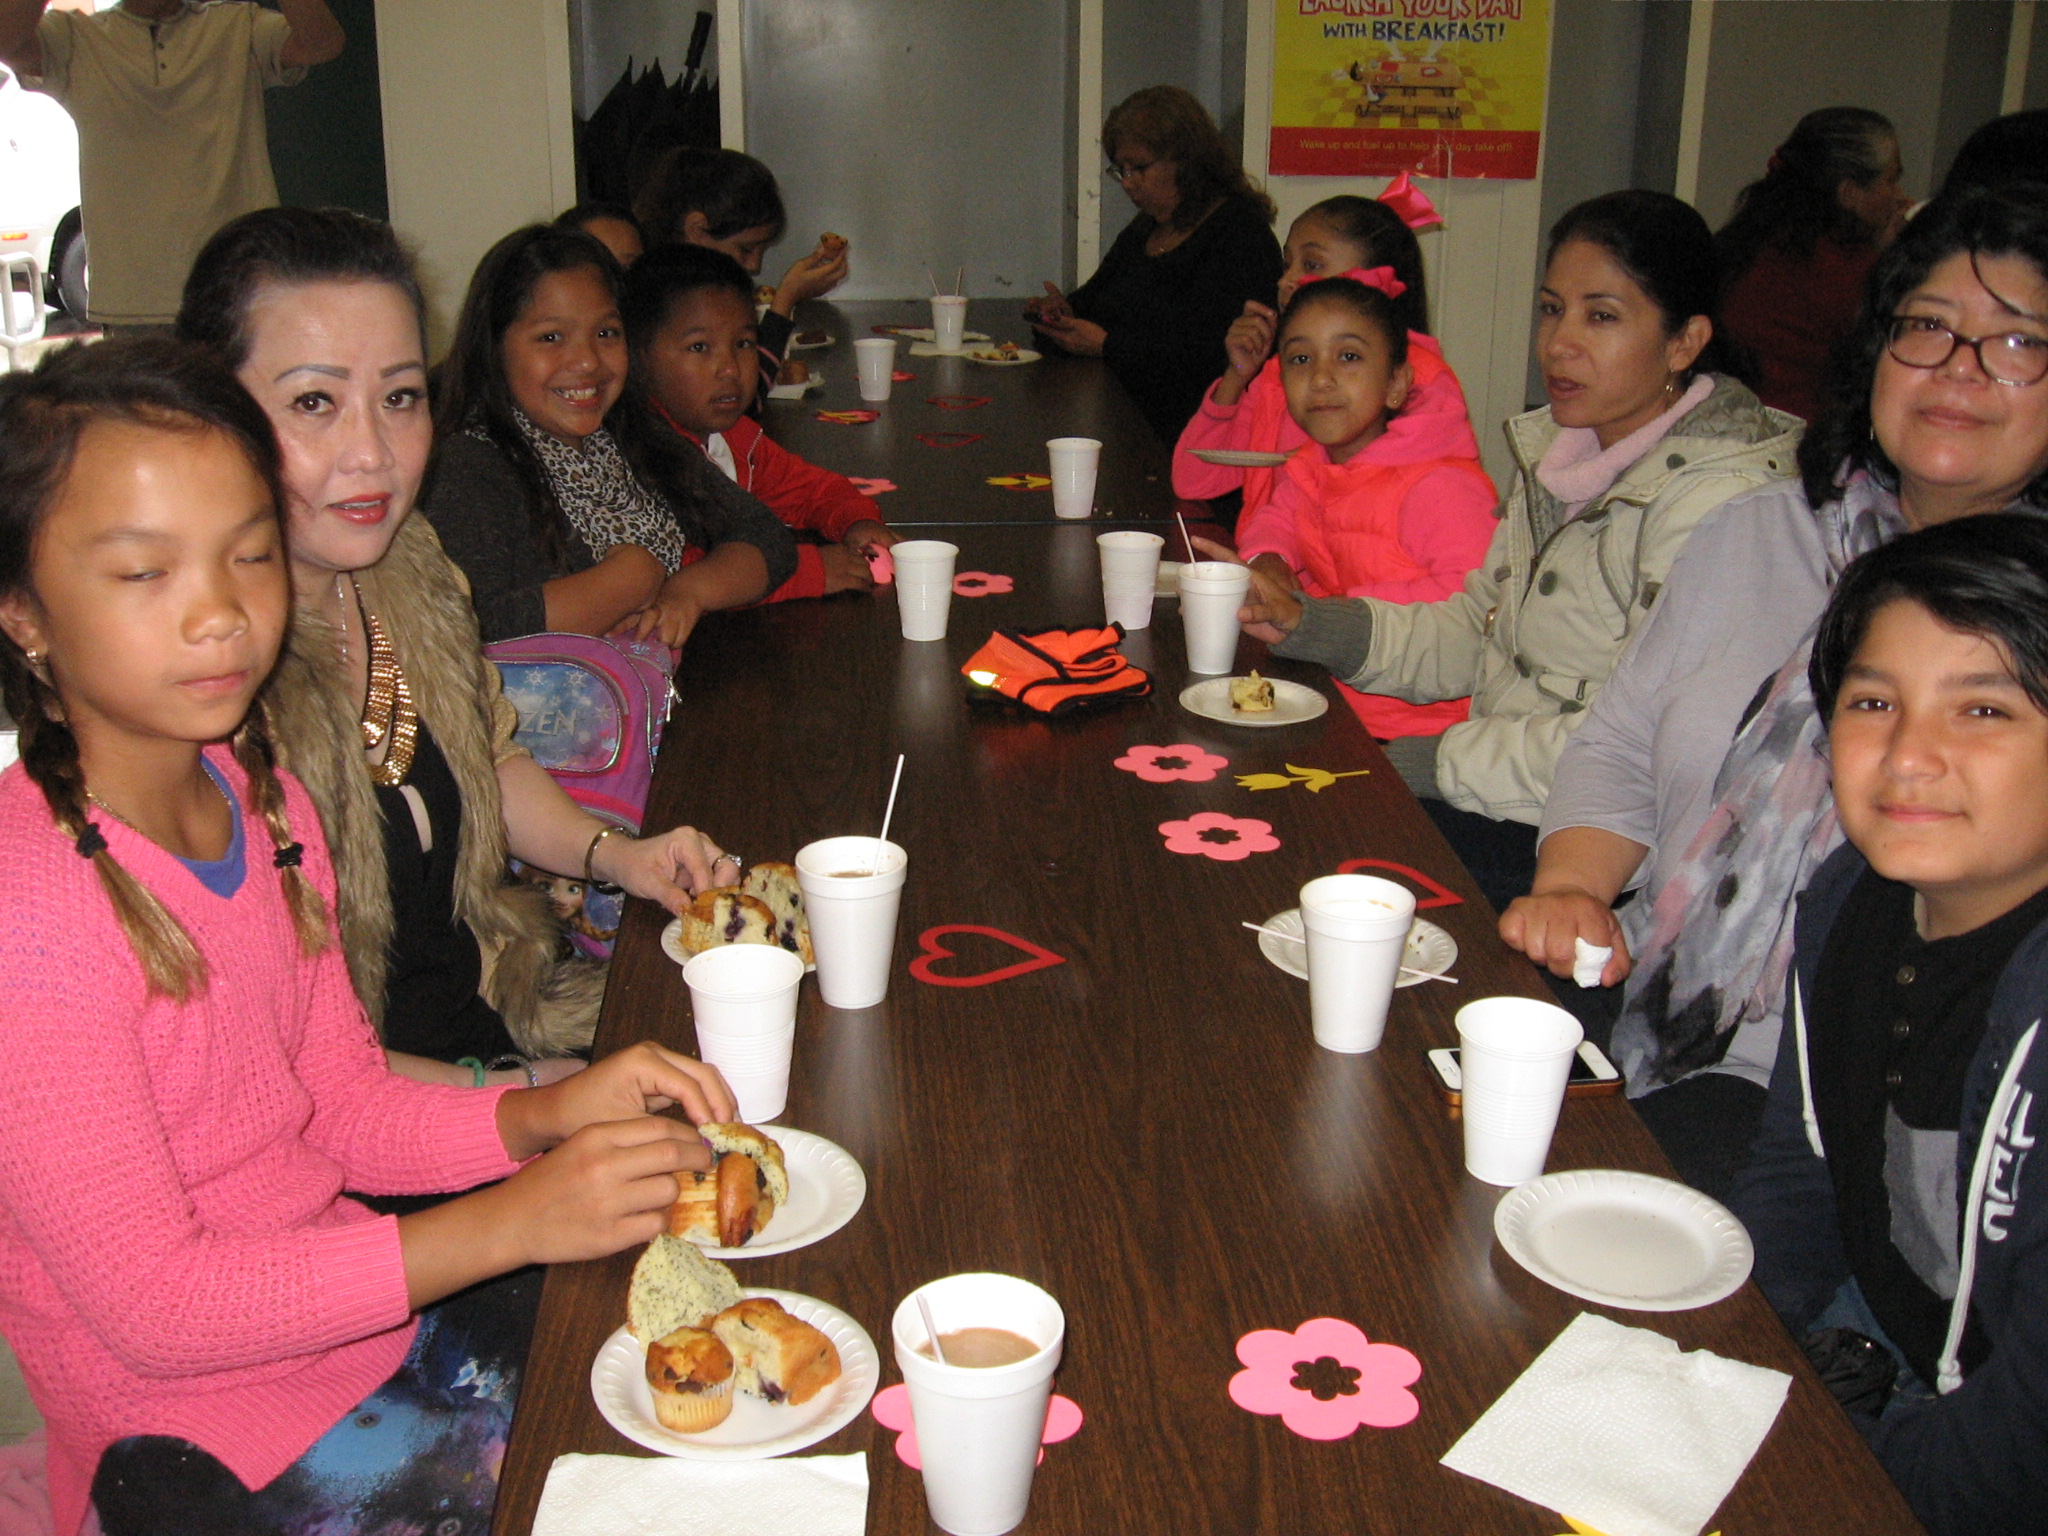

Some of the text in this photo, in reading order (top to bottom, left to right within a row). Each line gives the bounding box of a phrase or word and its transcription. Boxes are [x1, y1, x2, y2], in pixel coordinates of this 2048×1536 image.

[1323, 20, 1506, 43] WITH BREAKFAST!
[1300, 139, 1325, 149] Wake
[1328, 141, 1340, 151] up
[1343, 140, 1360, 149] and
[1363, 140, 1381, 149] fuel
[1383, 141, 1395, 151] up
[1397, 141, 1407, 150] to
[1410, 141, 1429, 152] help
[1456, 142, 1471, 152] day
[516, 708, 577, 736] ZEN
